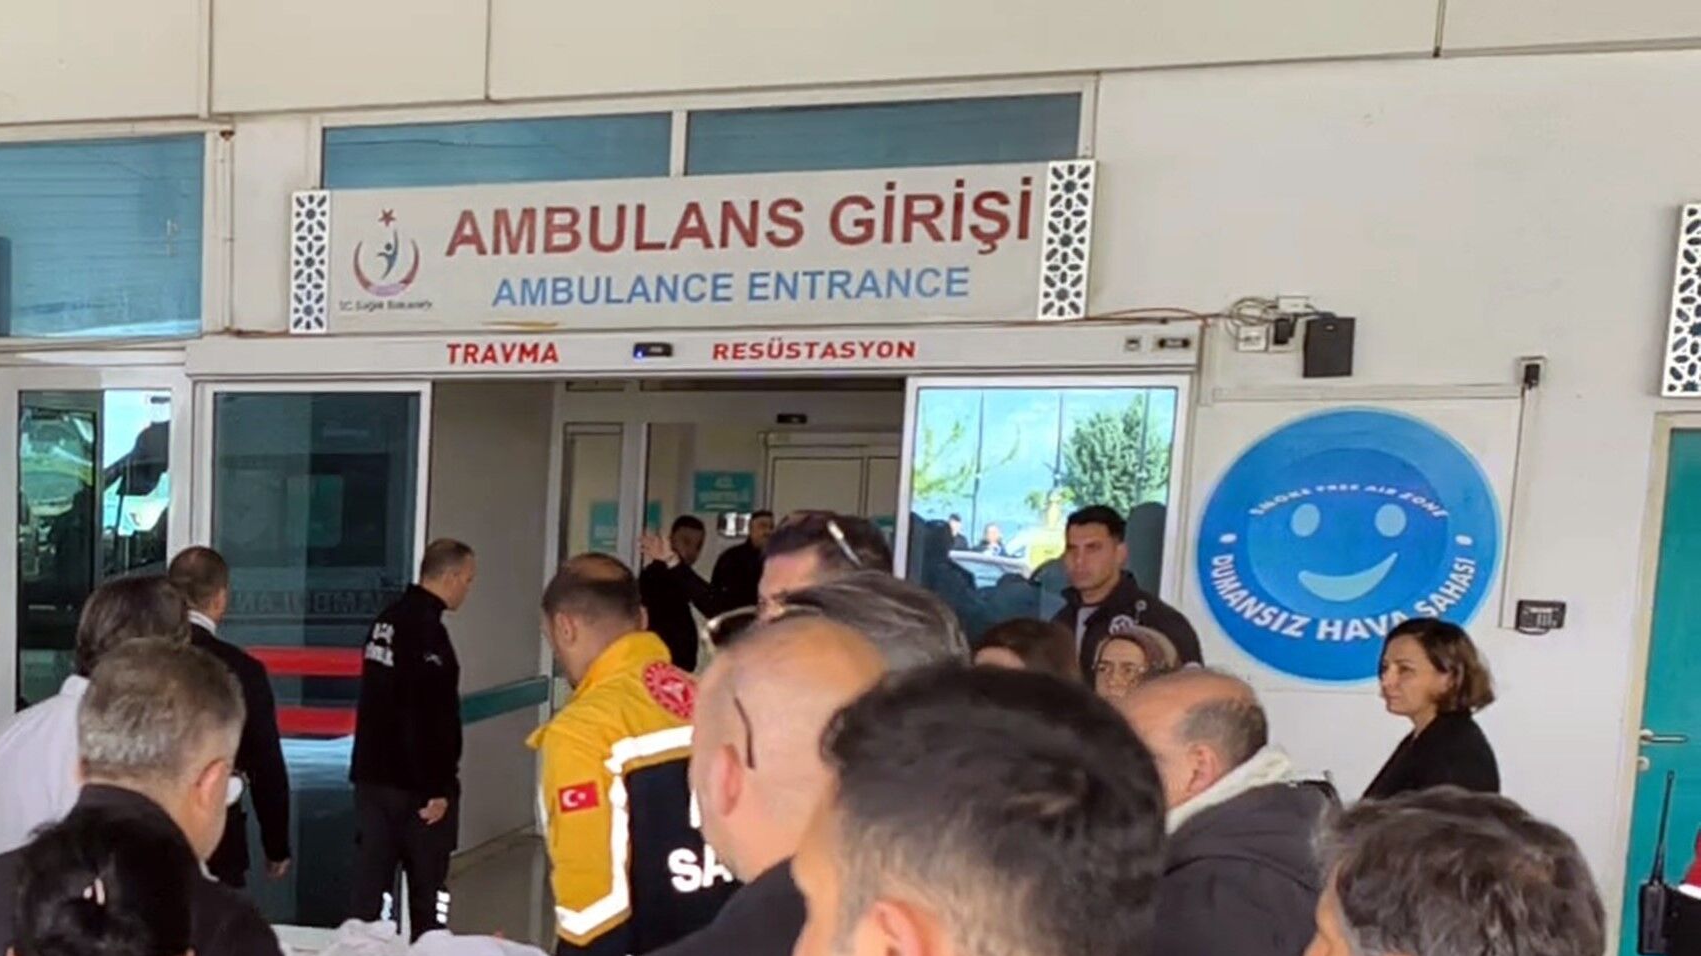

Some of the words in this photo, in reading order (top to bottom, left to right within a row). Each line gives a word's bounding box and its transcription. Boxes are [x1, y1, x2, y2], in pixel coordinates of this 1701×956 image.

[444, 195, 805, 257] AMBULANS
[828, 175, 1034, 255] GİRİŞİ
[491, 271, 734, 307] AMBULANCE
[747, 266, 971, 301] ENTRANCE
[446, 342, 560, 365] TRAVMA
[712, 337, 917, 360] RESÜSTASYON
[1211, 553, 1311, 639] DUMANSIZ
[1413, 556, 1477, 618] SAHASI
[667, 843, 734, 893] SA
